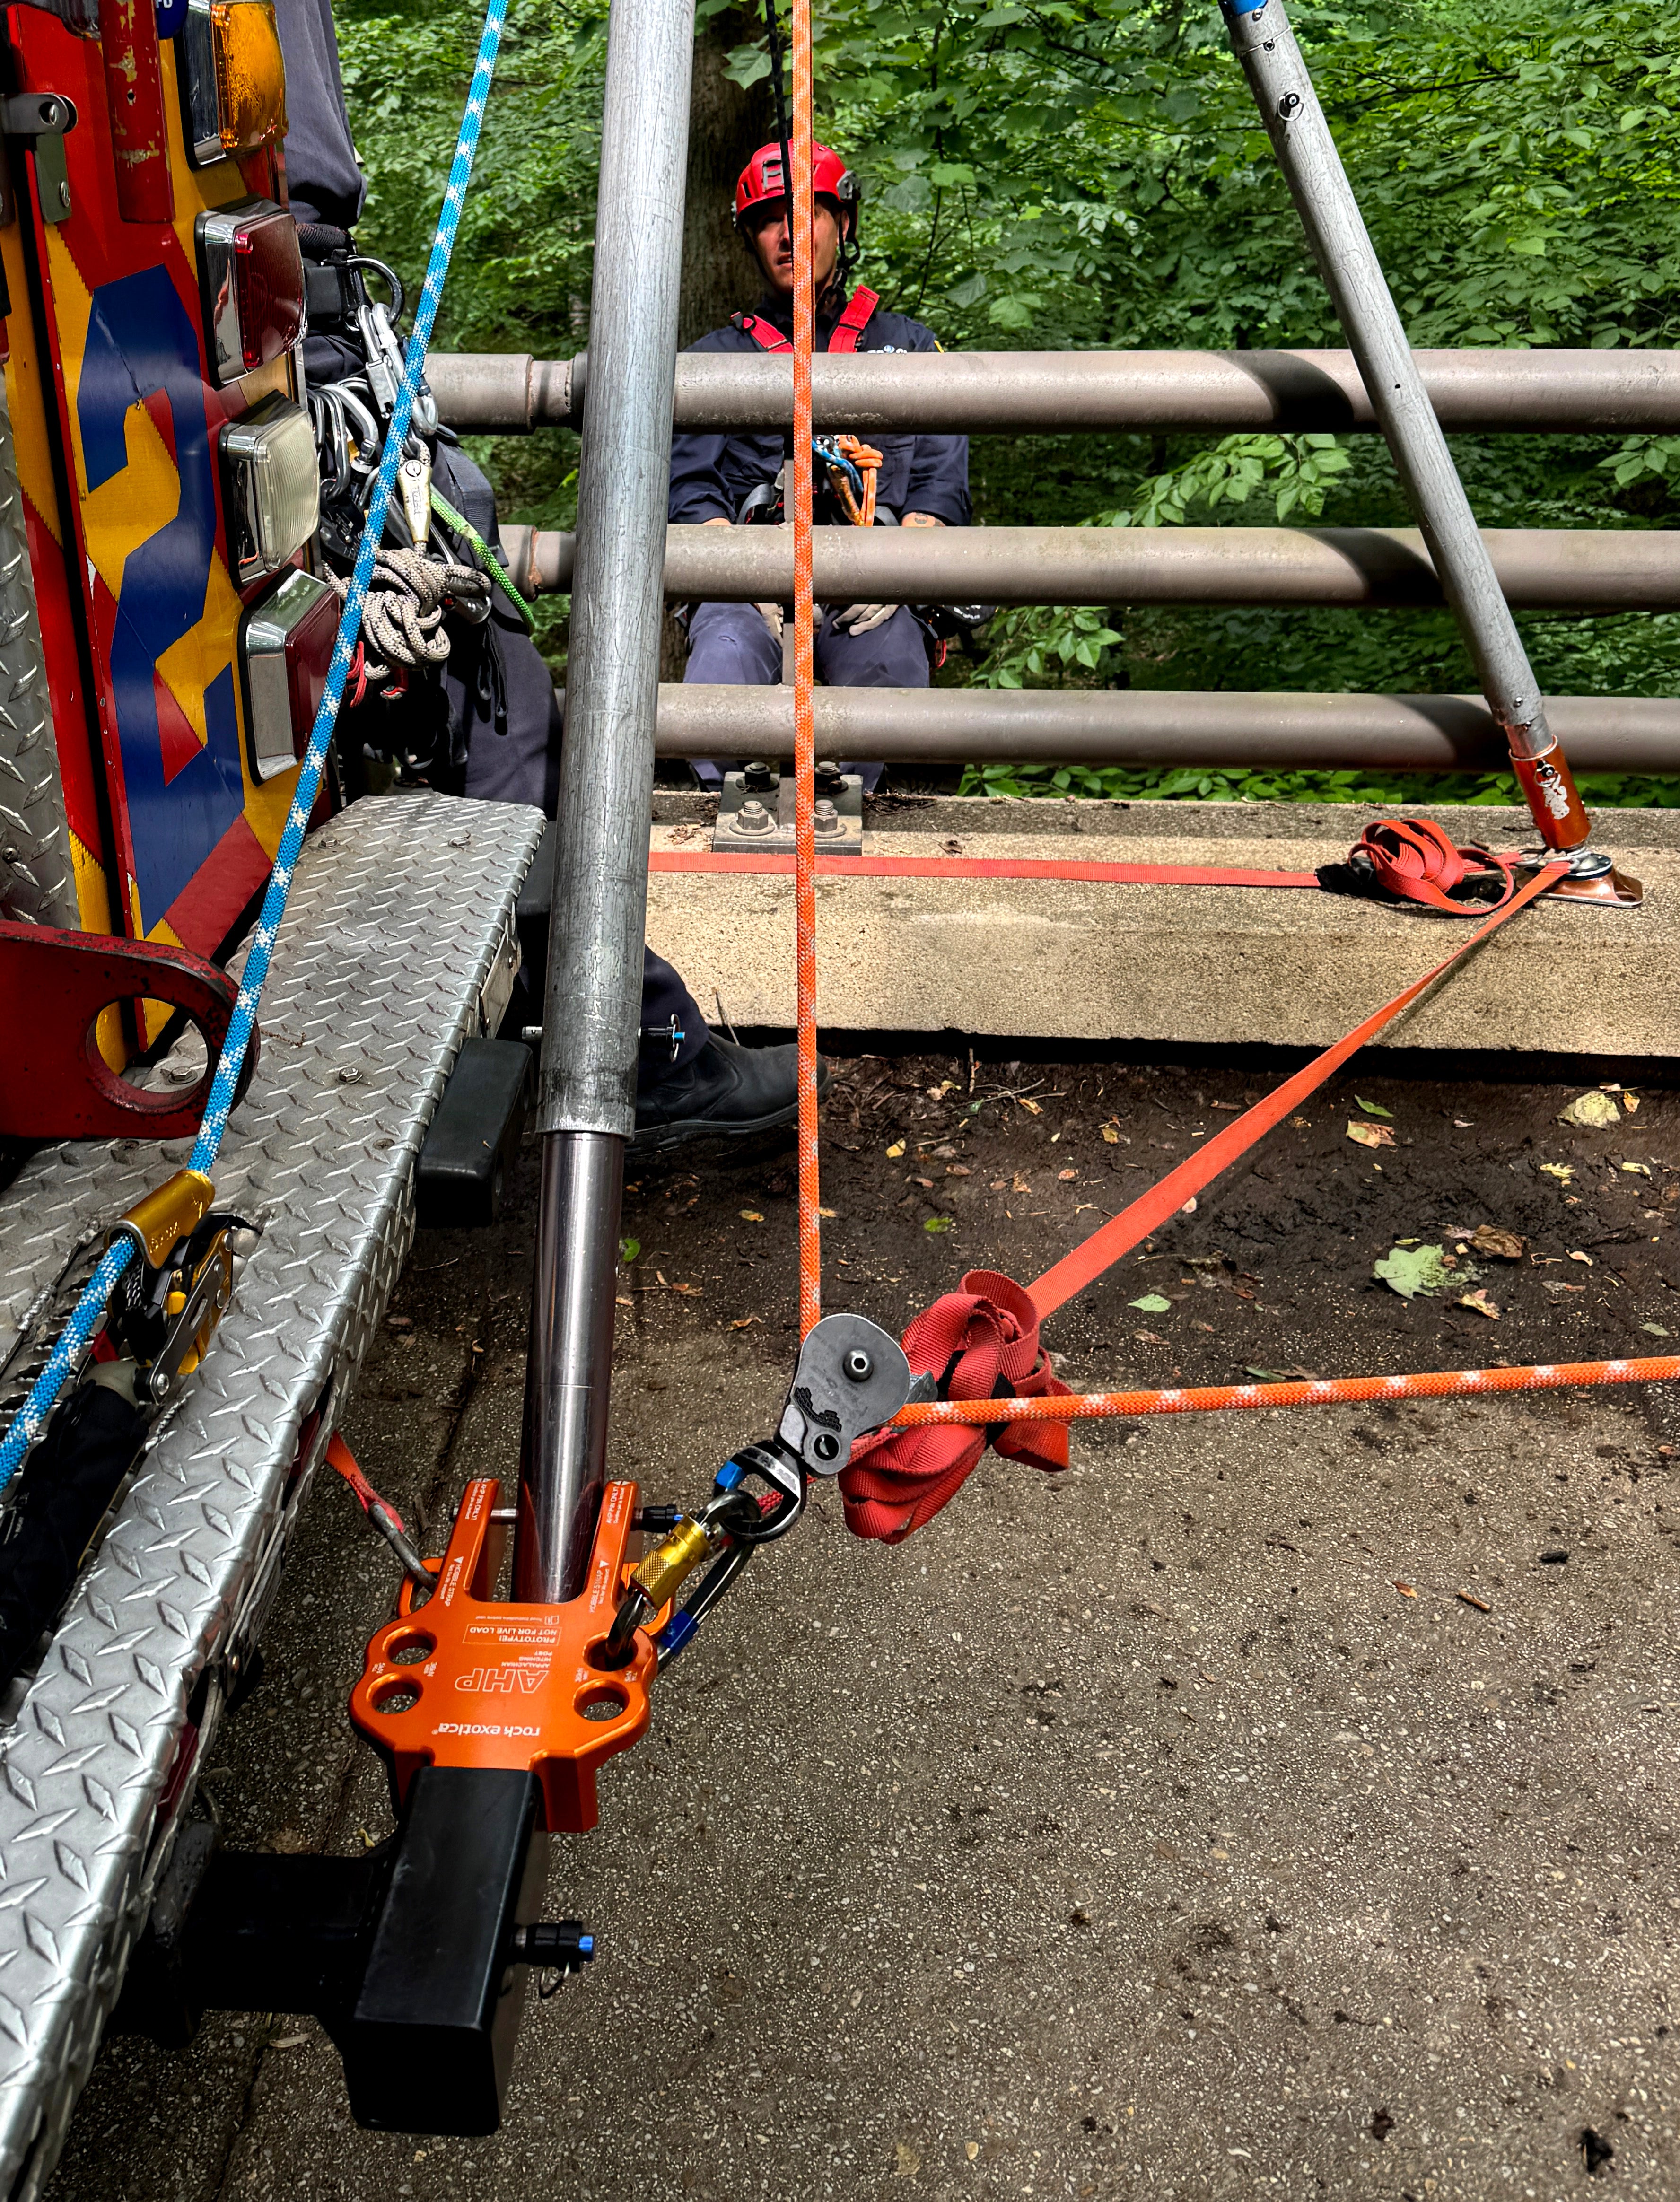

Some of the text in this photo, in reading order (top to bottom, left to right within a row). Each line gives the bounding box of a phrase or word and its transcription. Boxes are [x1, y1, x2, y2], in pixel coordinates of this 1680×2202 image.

[445, 1564, 461, 1606] HOBBLE STRAP
[589, 1590, 600, 1613] HOBBLE
[499, 1634, 556, 1643] PROTOTYPE!
[455, 1667, 550, 1693] AHP
[503, 1726, 540, 1737] rock
